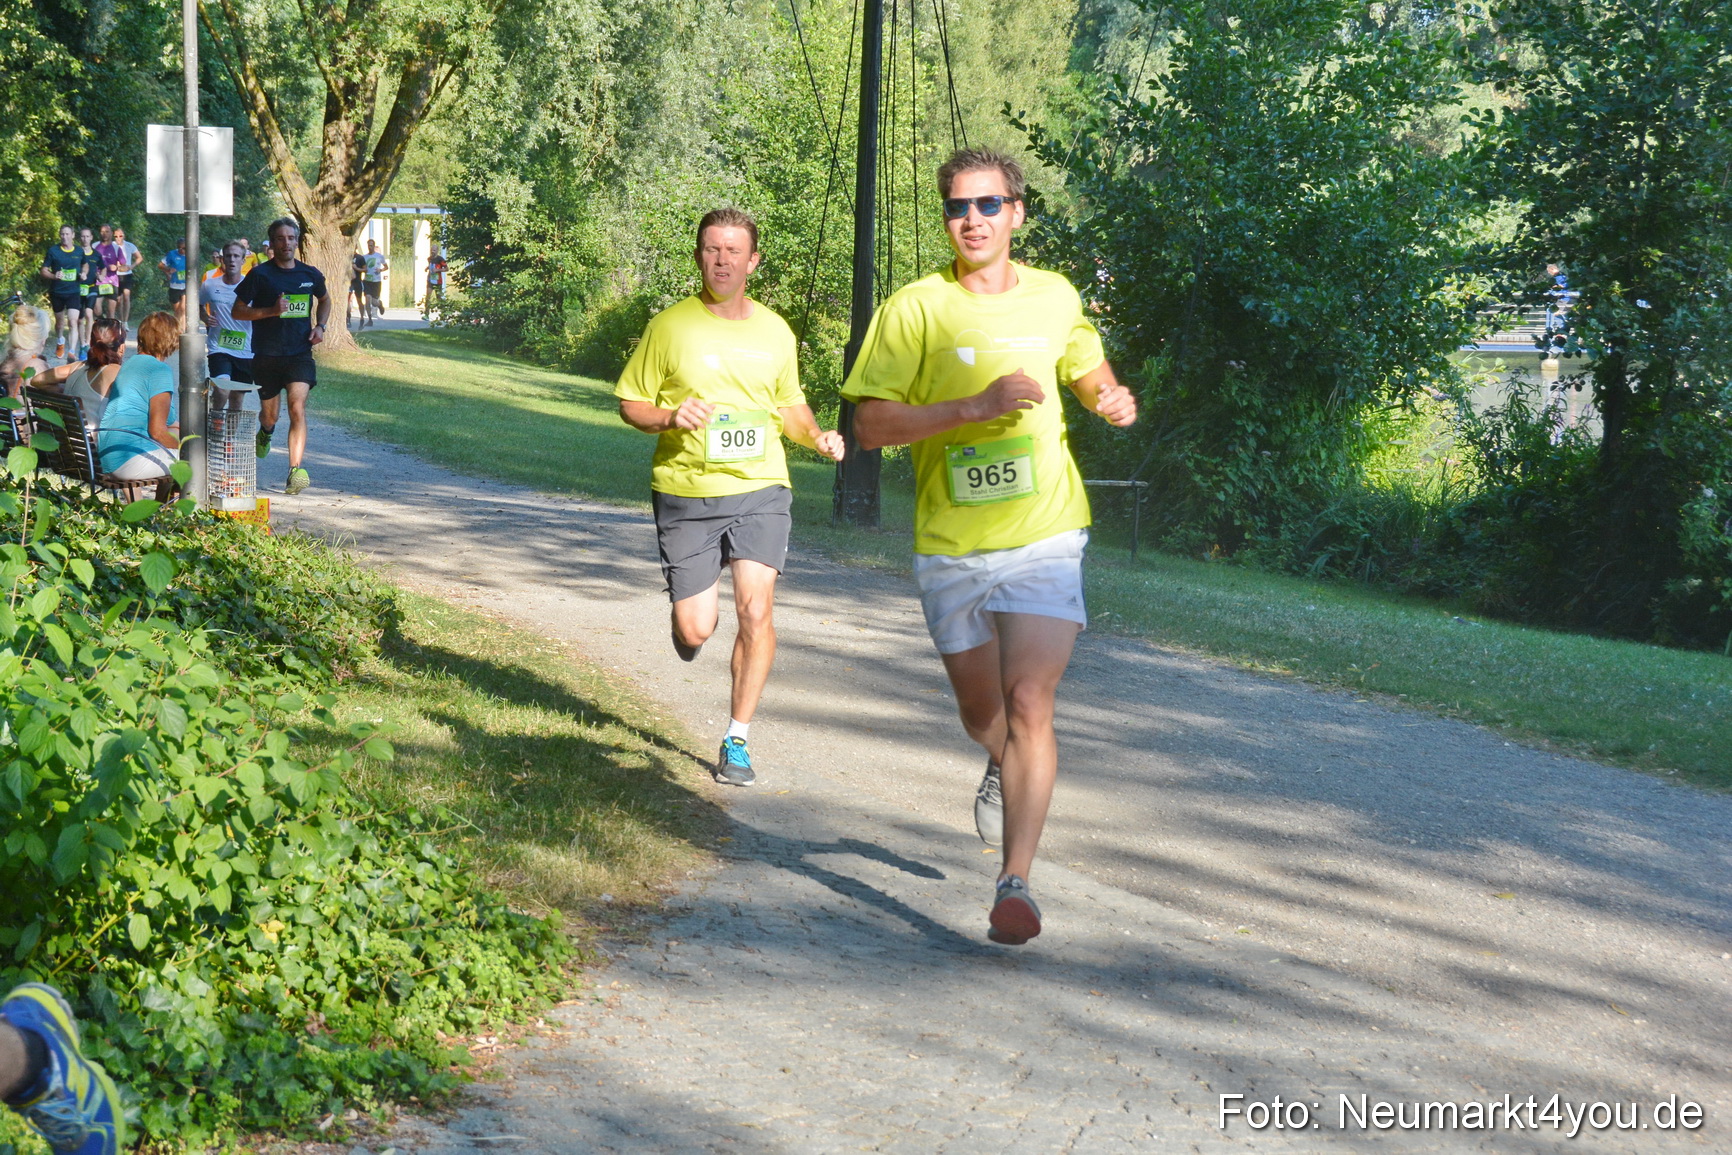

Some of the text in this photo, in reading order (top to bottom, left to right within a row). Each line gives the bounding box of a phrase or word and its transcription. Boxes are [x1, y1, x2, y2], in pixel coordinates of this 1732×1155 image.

[222, 335, 243, 346] 1758
[721, 429, 756, 448] 908
[967, 460, 1017, 488] 965
[969, 488, 988, 496] Stahl
[988, 483, 1019, 494] Christian
